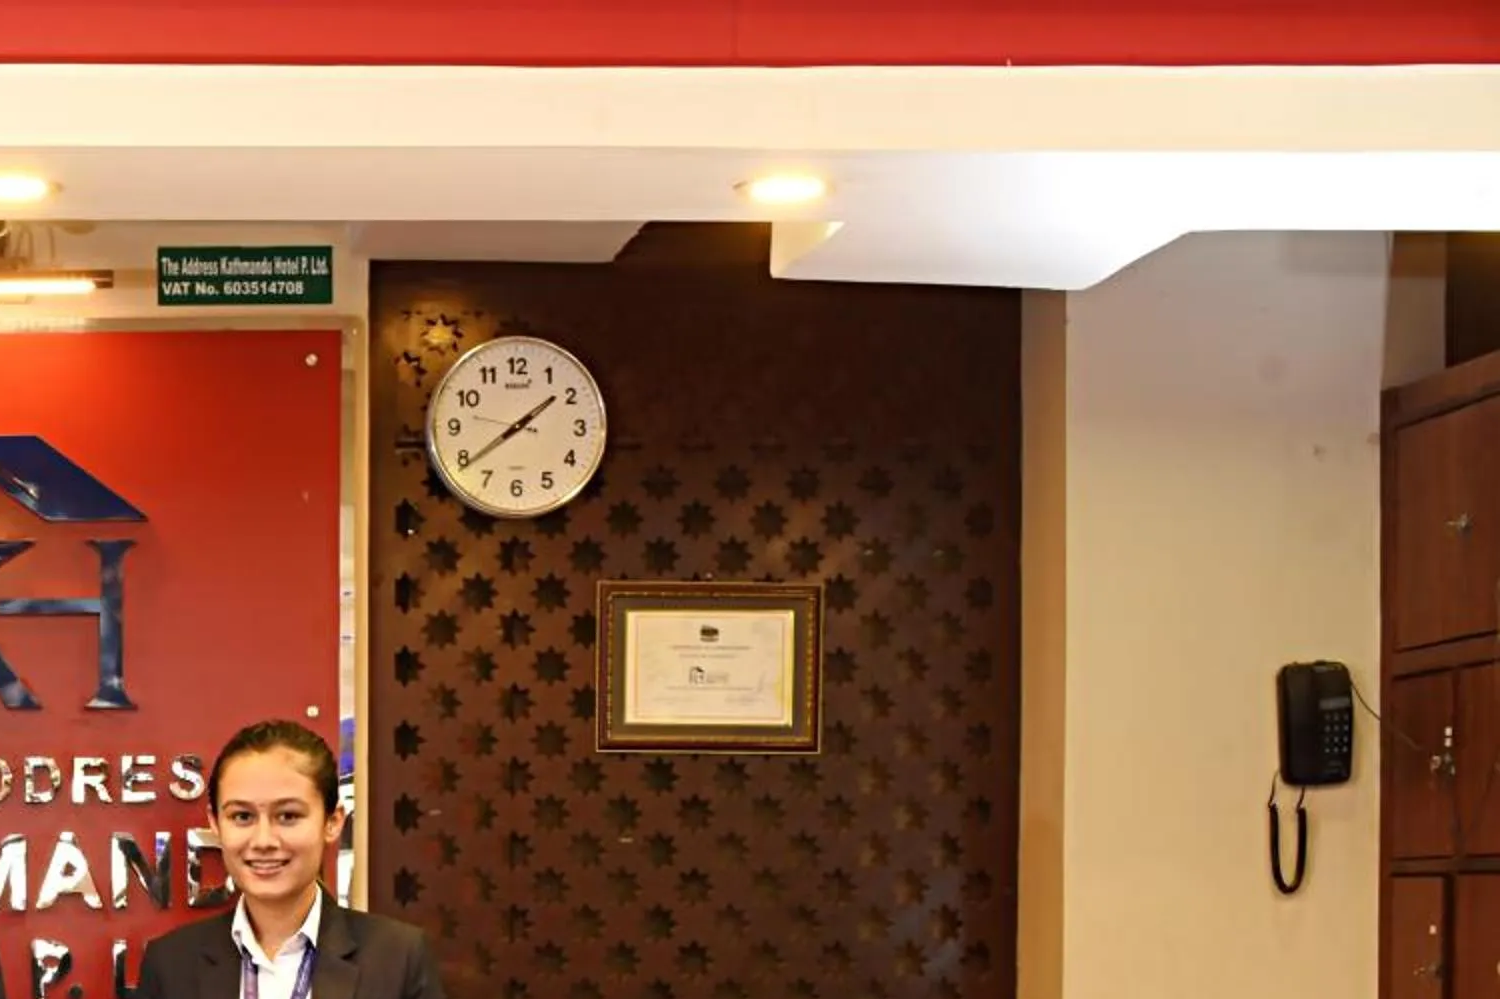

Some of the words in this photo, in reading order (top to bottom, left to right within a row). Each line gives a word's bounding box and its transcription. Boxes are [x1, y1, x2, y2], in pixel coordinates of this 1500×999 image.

[160, 256, 180, 276] The
[181, 256, 218, 276] Address
[220, 256, 273, 276] Kathmandu
[274, 256, 299, 276] Hotel
[301, 256, 309, 276] P.
[311, 256, 329, 276] Ltd.
[161, 281, 190, 295] VAT
[195, 282, 219, 295] No.
[223, 281, 304, 295] 603514708
[480, 366, 497, 384] 11
[507, 357, 528, 376] 12
[544, 367, 553, 385] 1
[456, 389, 480, 408] 10
[565, 387, 577, 405] 2
[447, 417, 461, 436] 9
[573, 419, 586, 437] 3
[457, 449, 469, 468] 8
[563, 449, 577, 467] 4
[480, 470, 493, 489] 7
[509, 479, 523, 497] 6
[541, 471, 554, 489] 5
